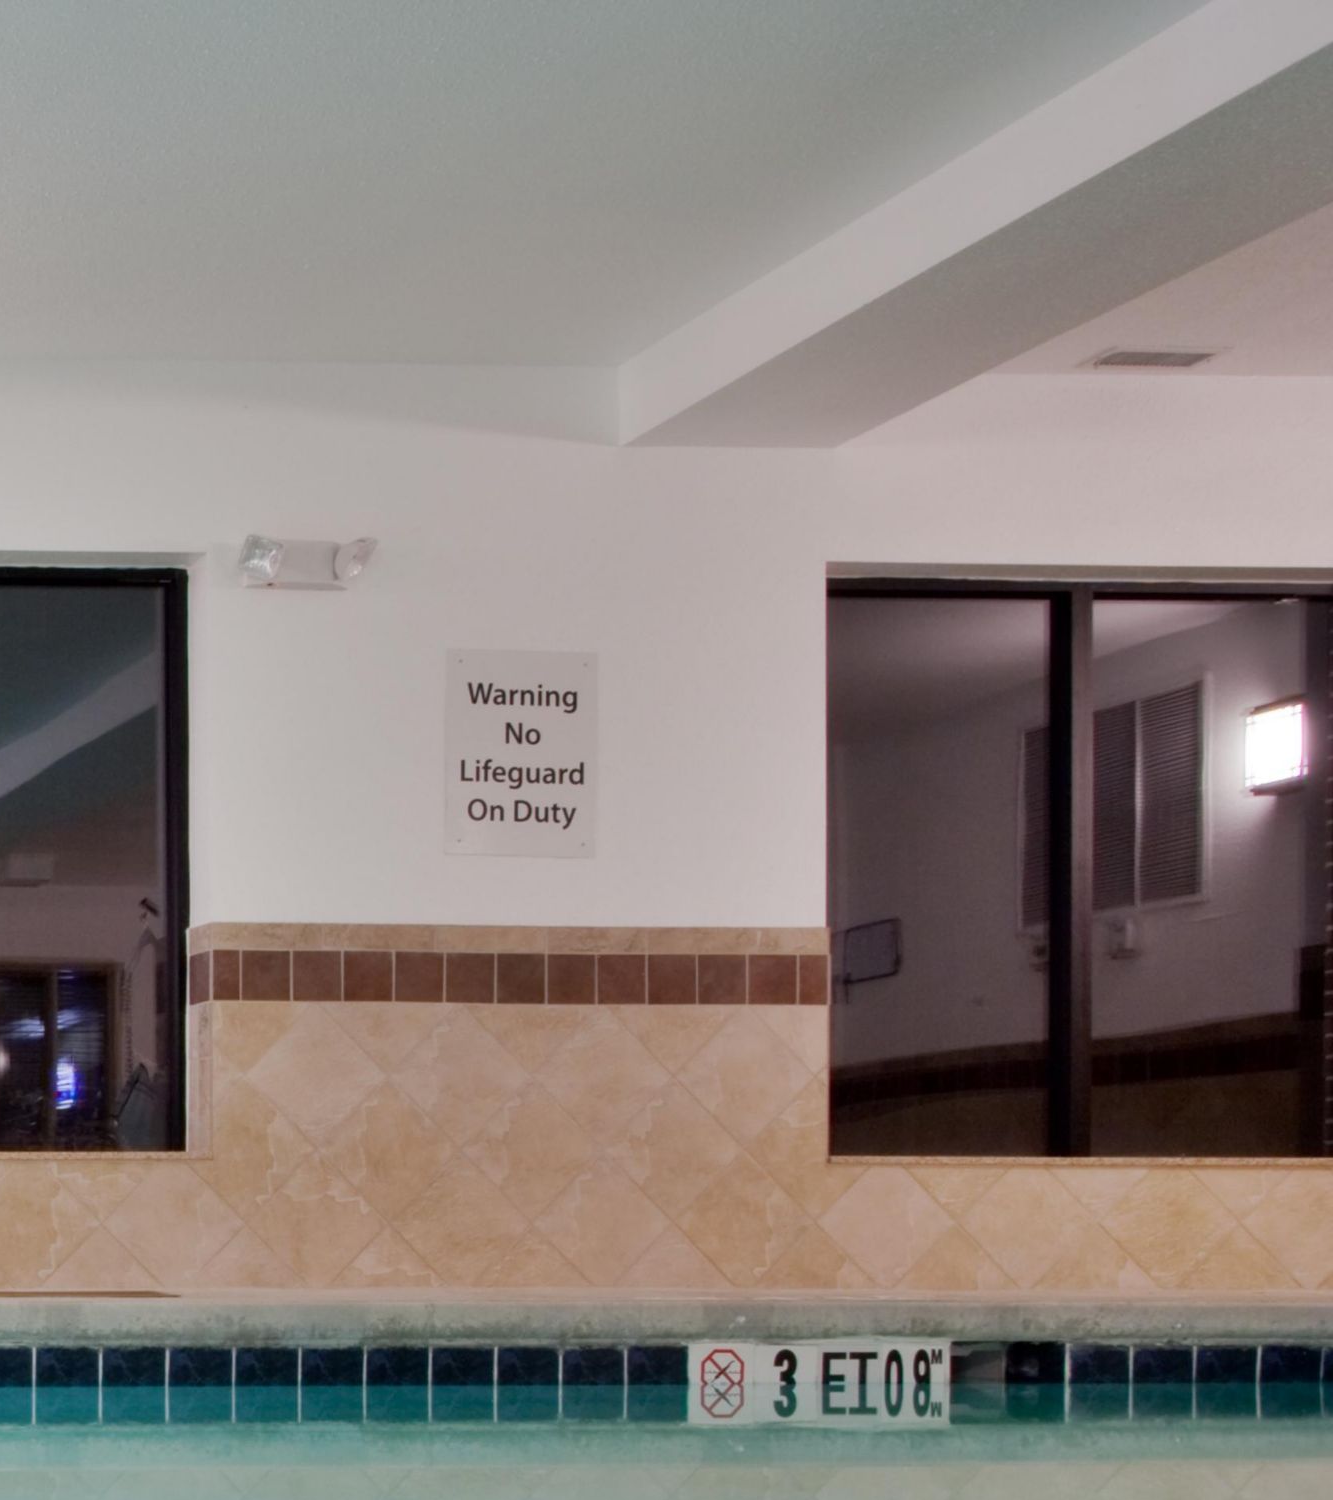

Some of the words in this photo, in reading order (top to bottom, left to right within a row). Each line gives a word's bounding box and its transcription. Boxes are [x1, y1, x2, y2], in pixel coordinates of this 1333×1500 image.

[467, 682, 578, 714] Warning
[505, 722, 541, 745] No
[460, 759, 585, 789] Lifeguard
[467, 799, 505, 822] On
[514, 800, 577, 830] Duty
